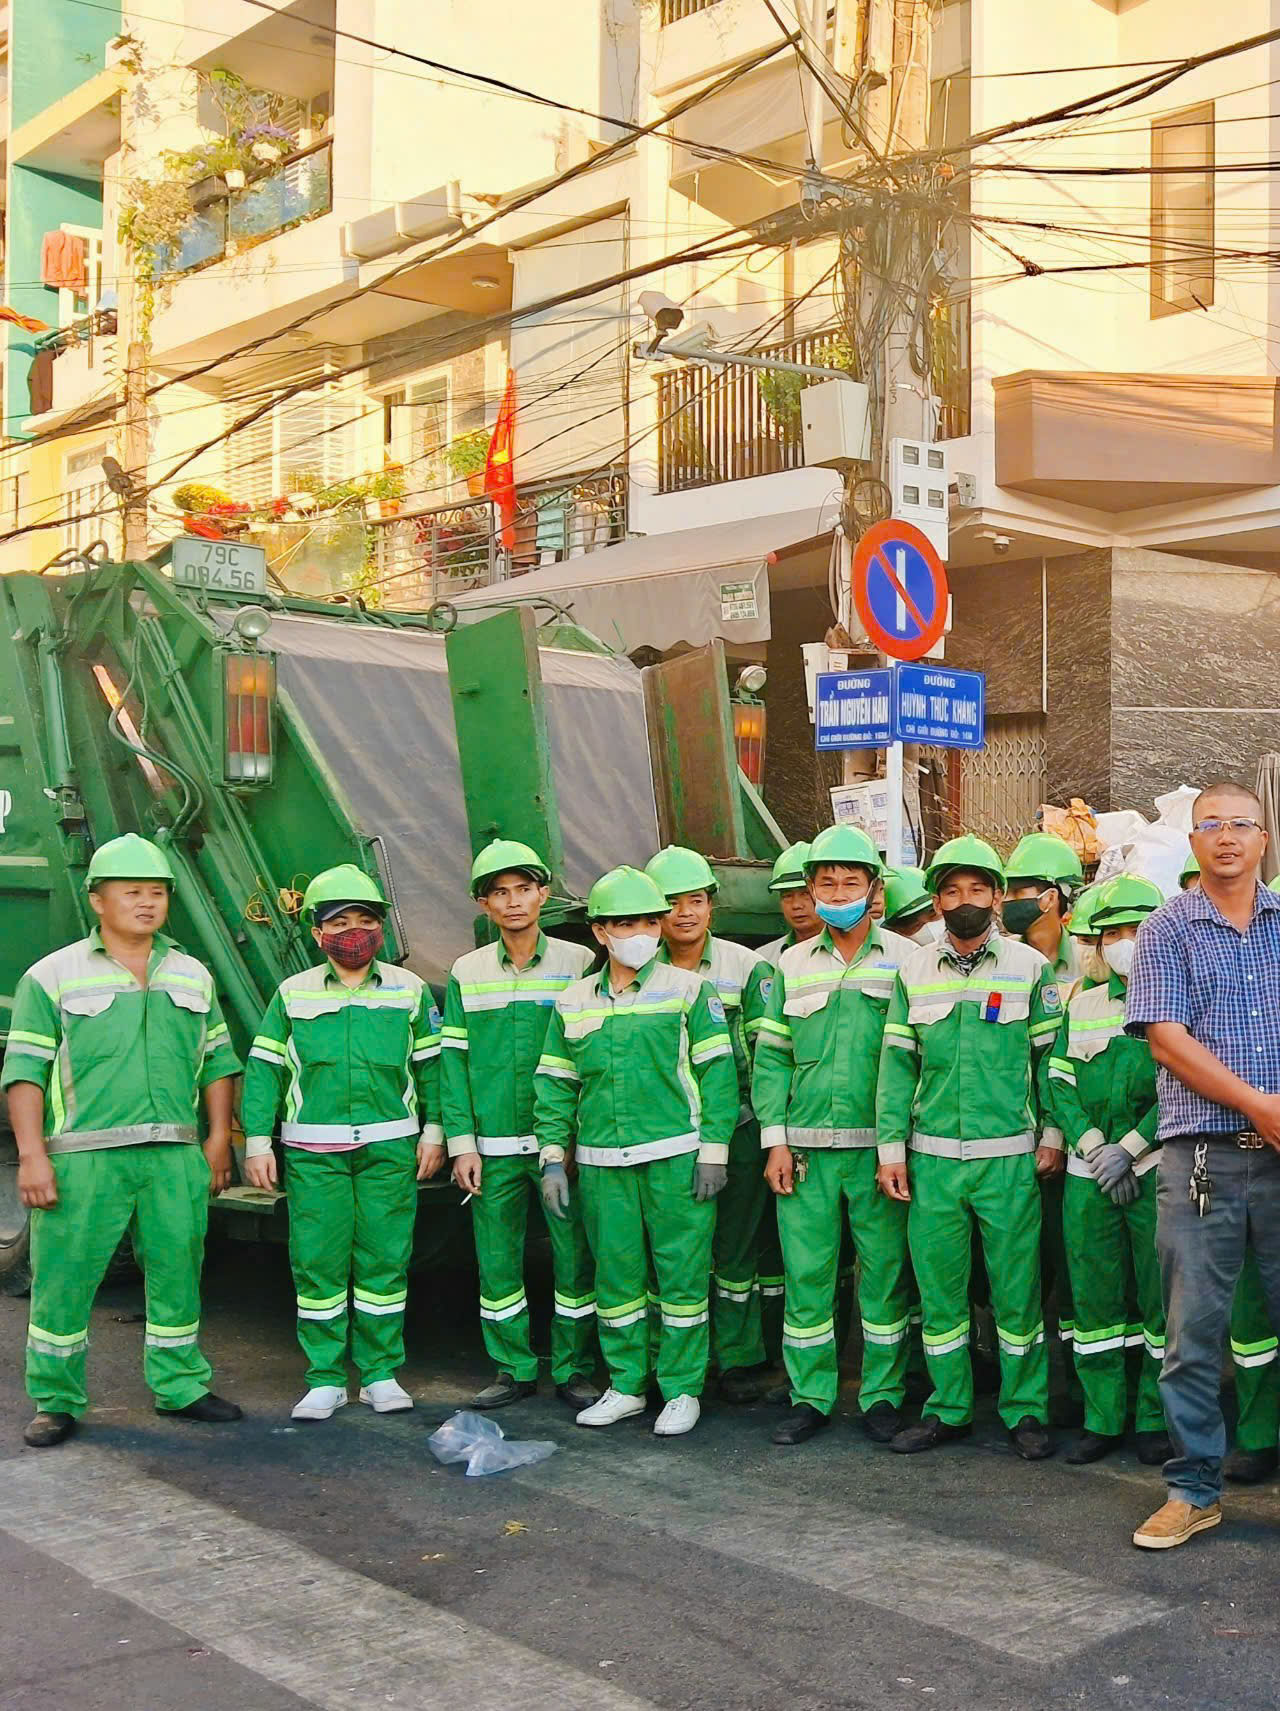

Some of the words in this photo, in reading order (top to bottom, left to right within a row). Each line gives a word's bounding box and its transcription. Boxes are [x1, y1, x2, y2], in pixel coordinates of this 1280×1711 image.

[201, 544, 240, 566] 79C
[837, 677, 871, 690] ĐƯỜNG
[923, 674, 956, 688] ĐƯỜNG
[930, 691, 949, 723] THÚC
[952, 695, 977, 726] KHÁNG
